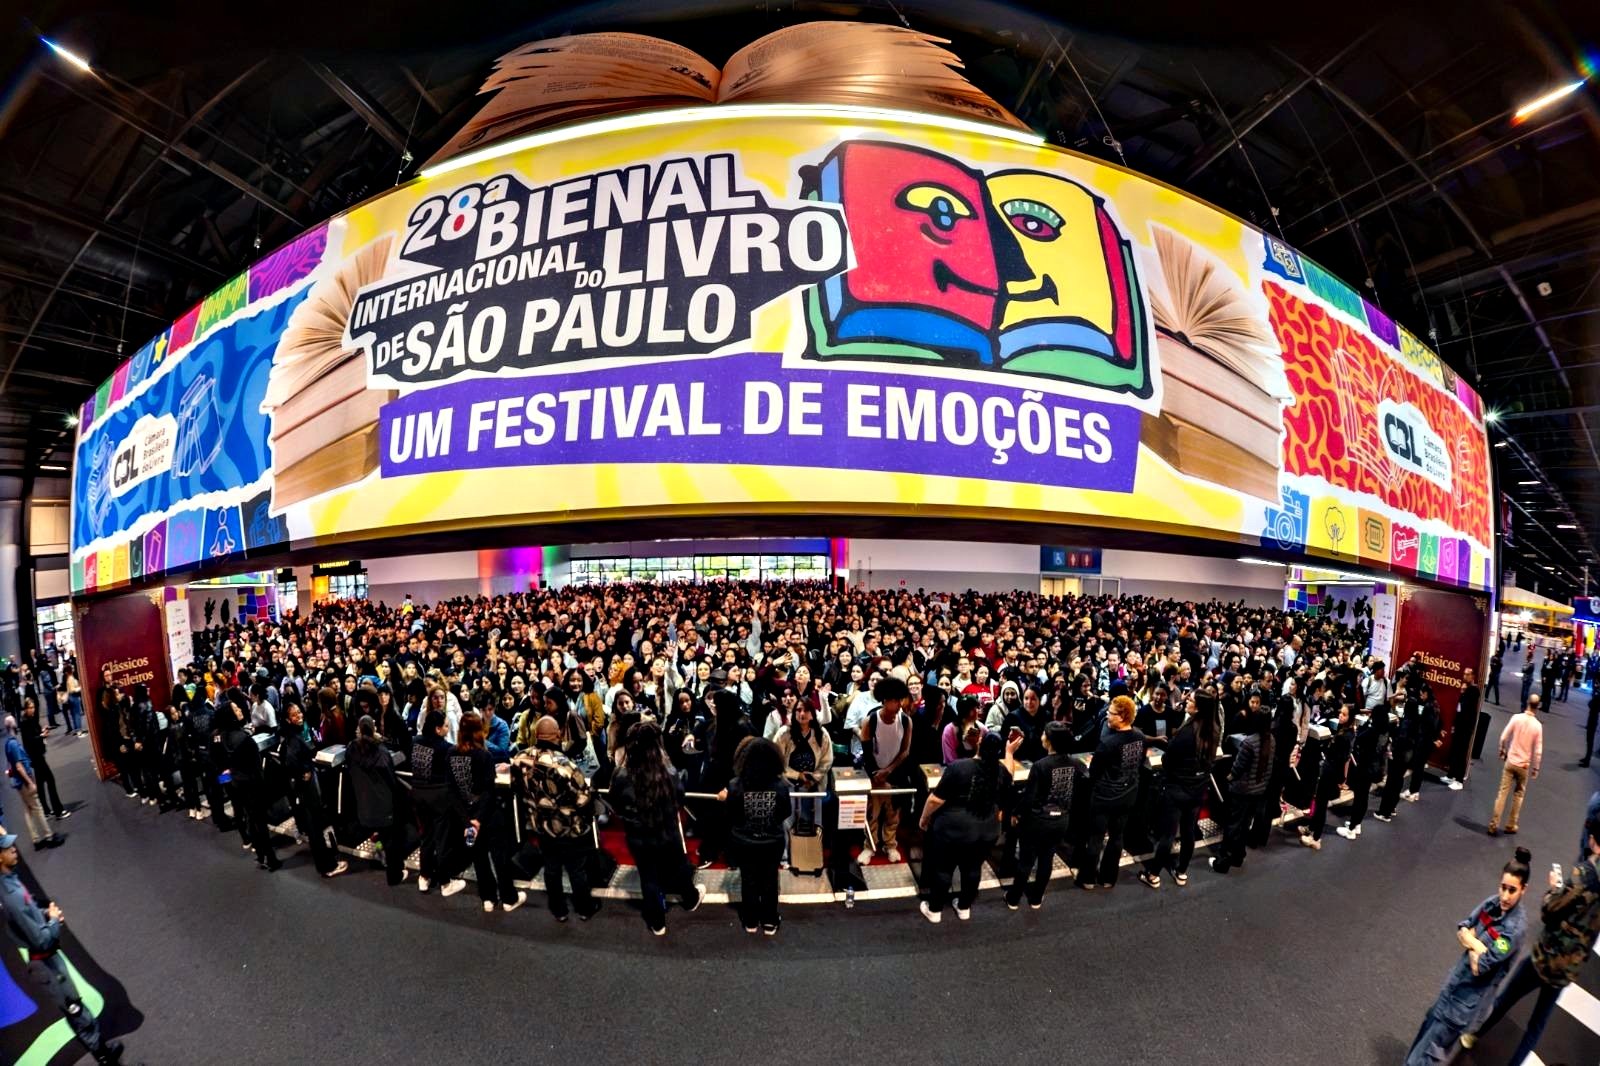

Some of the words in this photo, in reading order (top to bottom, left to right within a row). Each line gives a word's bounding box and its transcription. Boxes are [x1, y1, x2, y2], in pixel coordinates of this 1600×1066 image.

[403, 177, 510, 256] 28ª
[475, 156, 755, 261] BIENAL
[353, 242, 585, 329] INTERNACIONAL
[574, 270, 603, 288] DO
[601, 211, 842, 288] LIVRO
[376, 332, 404, 369] DE
[401, 301, 507, 376] SÃO
[518, 284, 736, 356] PAULO
[389, 407, 453, 464] UM
[467, 382, 721, 452] FESTIVAL
[743, 381, 823, 436] DE
[847, 383, 1113, 465] EMOÇÕES
